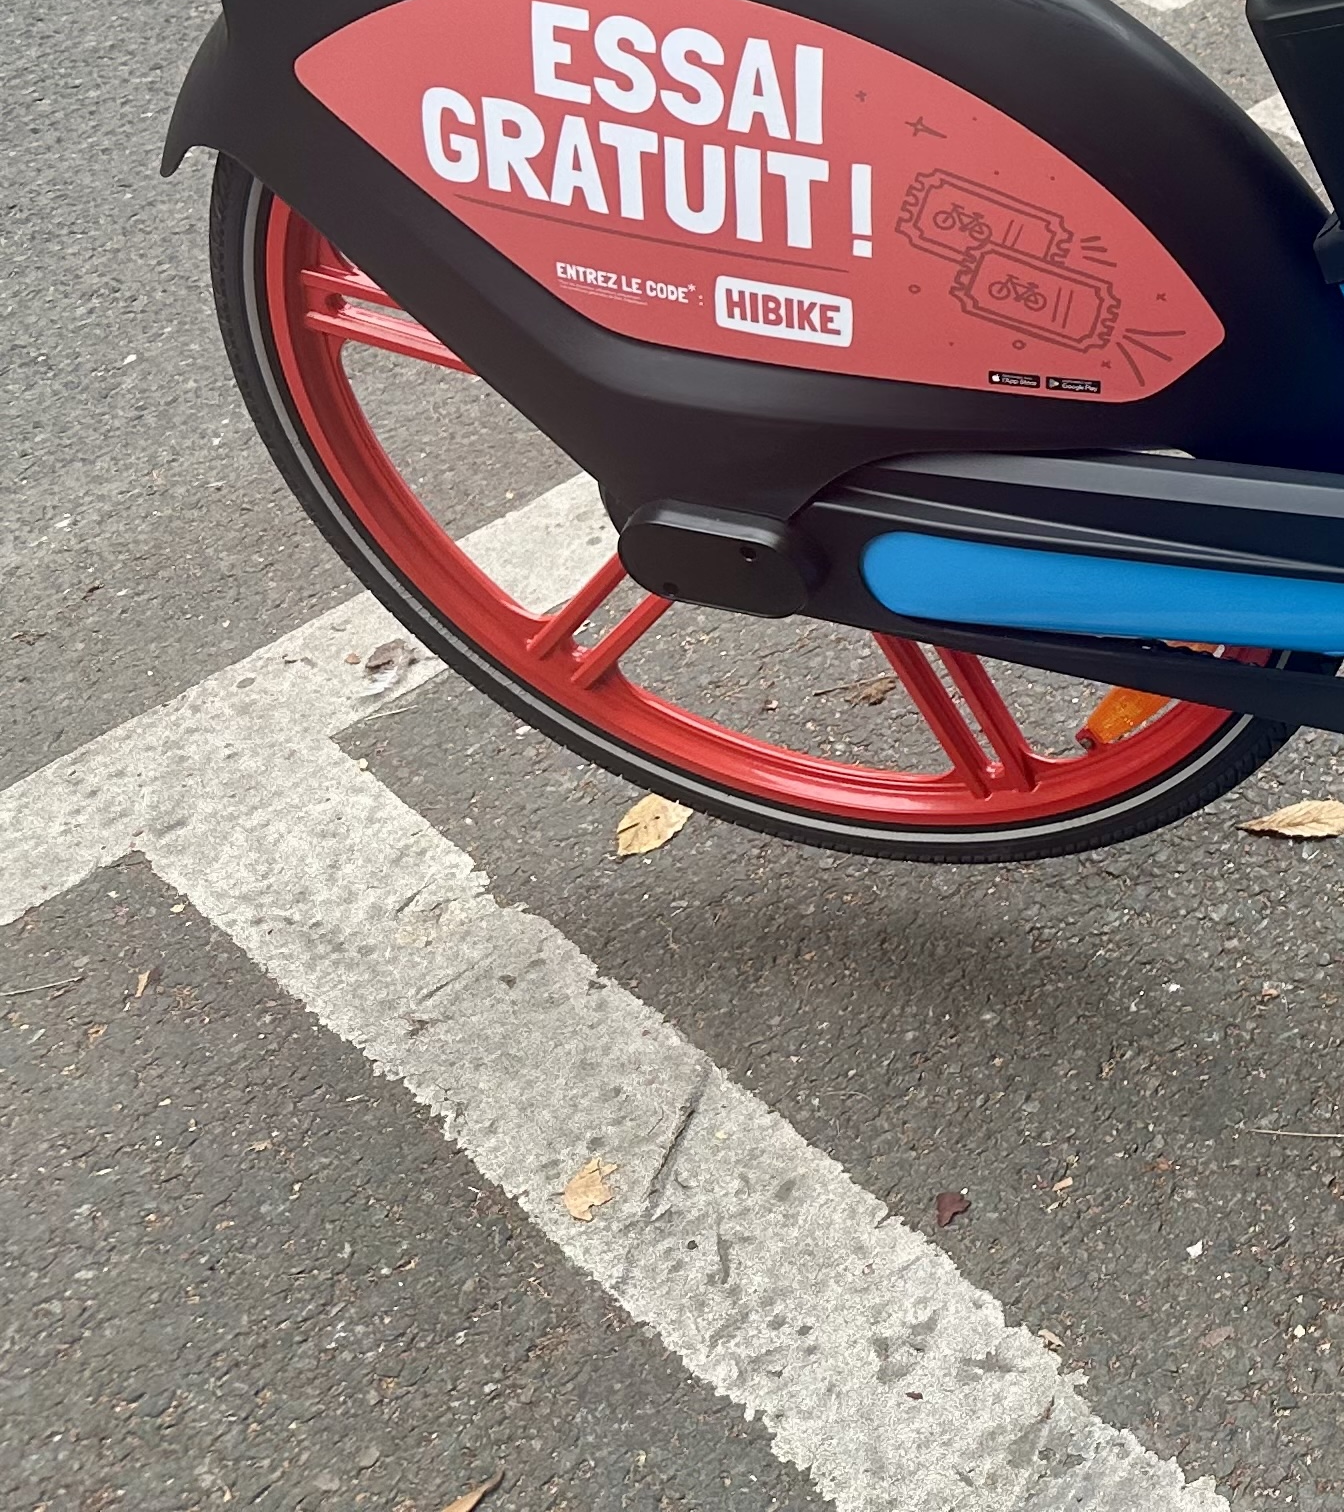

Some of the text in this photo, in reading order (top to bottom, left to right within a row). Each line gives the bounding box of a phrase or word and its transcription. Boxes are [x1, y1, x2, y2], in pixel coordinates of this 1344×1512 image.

[531, 0, 824, 144] ESSAI
[422, 86, 873, 258] GRATUIT !
[556, 262, 618, 289] ENTREZ
[622, 274, 642, 294] LE
[725, 288, 842, 336] HIBIKE
[1062, 382, 1084, 392] Google
[1084, 384, 1098, 392] Play
